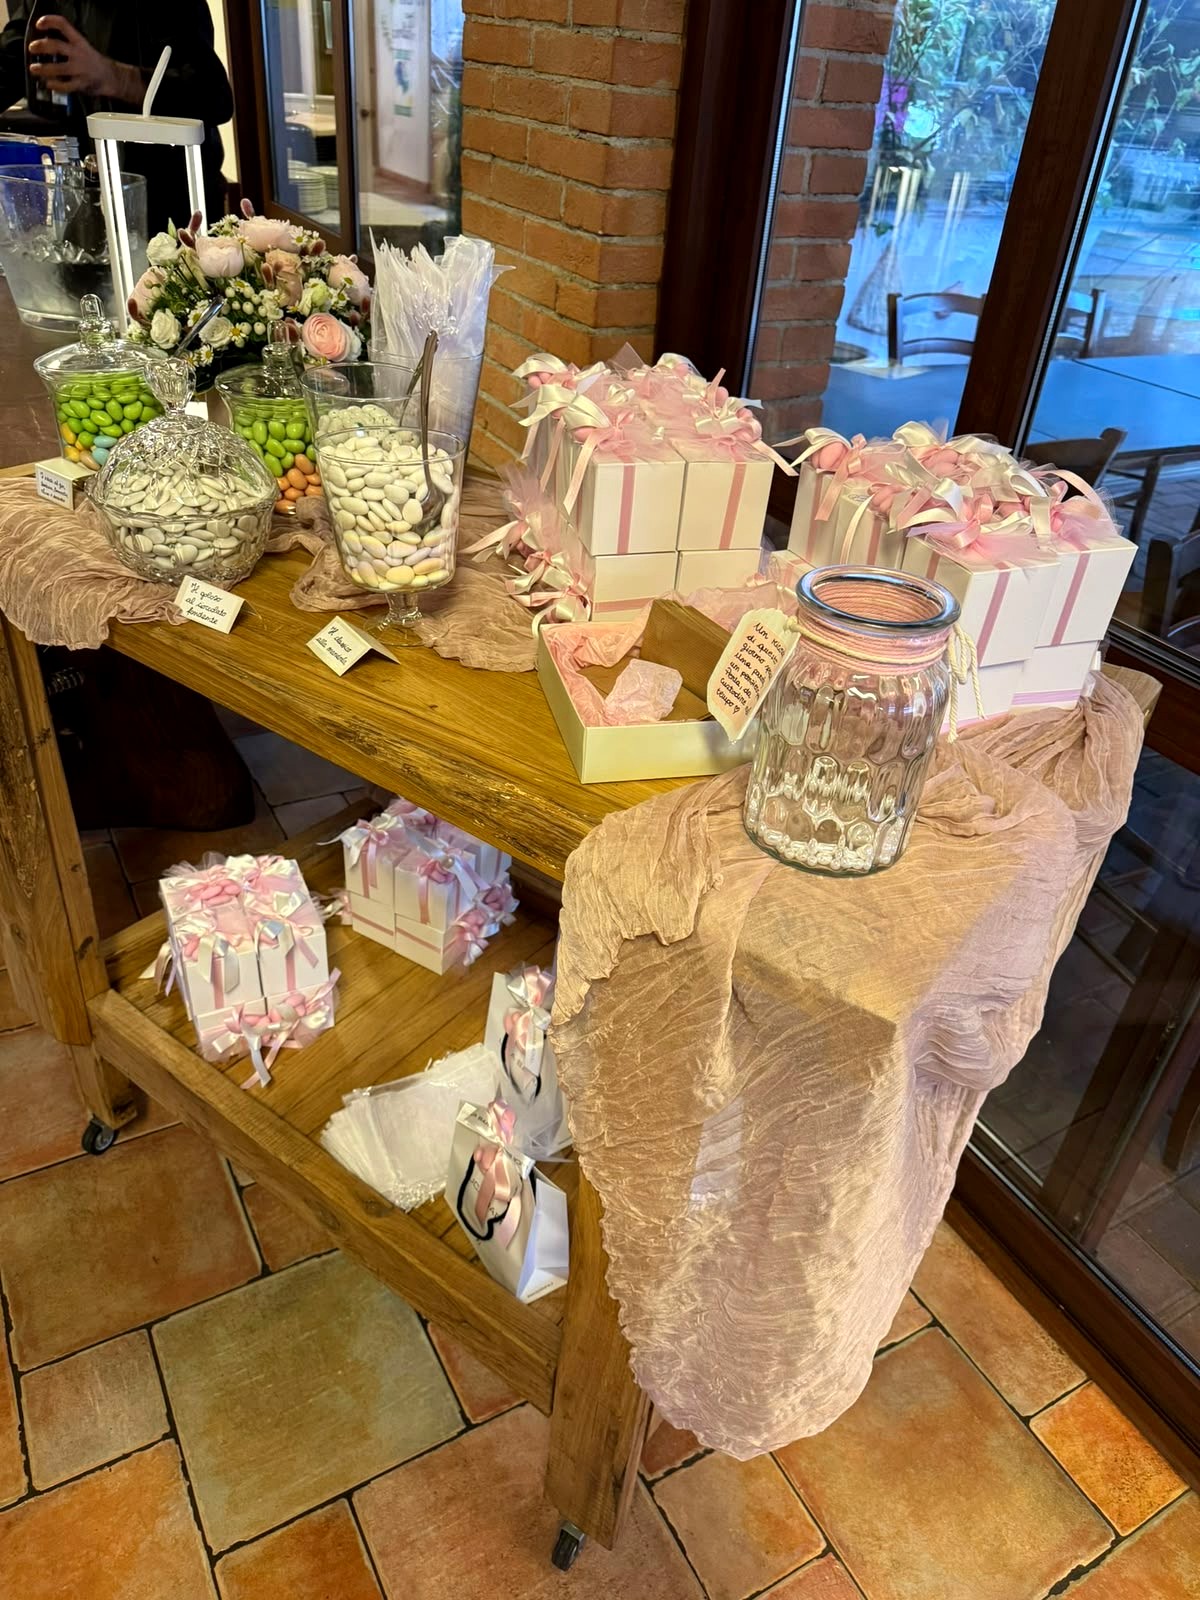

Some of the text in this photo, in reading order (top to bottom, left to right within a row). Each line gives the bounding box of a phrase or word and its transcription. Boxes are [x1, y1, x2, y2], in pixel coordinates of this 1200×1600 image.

[185, 597, 196, 605] al
[187, 607, 218, 625] fondente
[746, 635, 757, 644] di
[753, 622, 768, 640] Un
[740, 642, 765, 664] giorno
[730, 661, 740, 672] un
[716, 688, 735, 707] tempo
[721, 677, 747, 706] custodire
